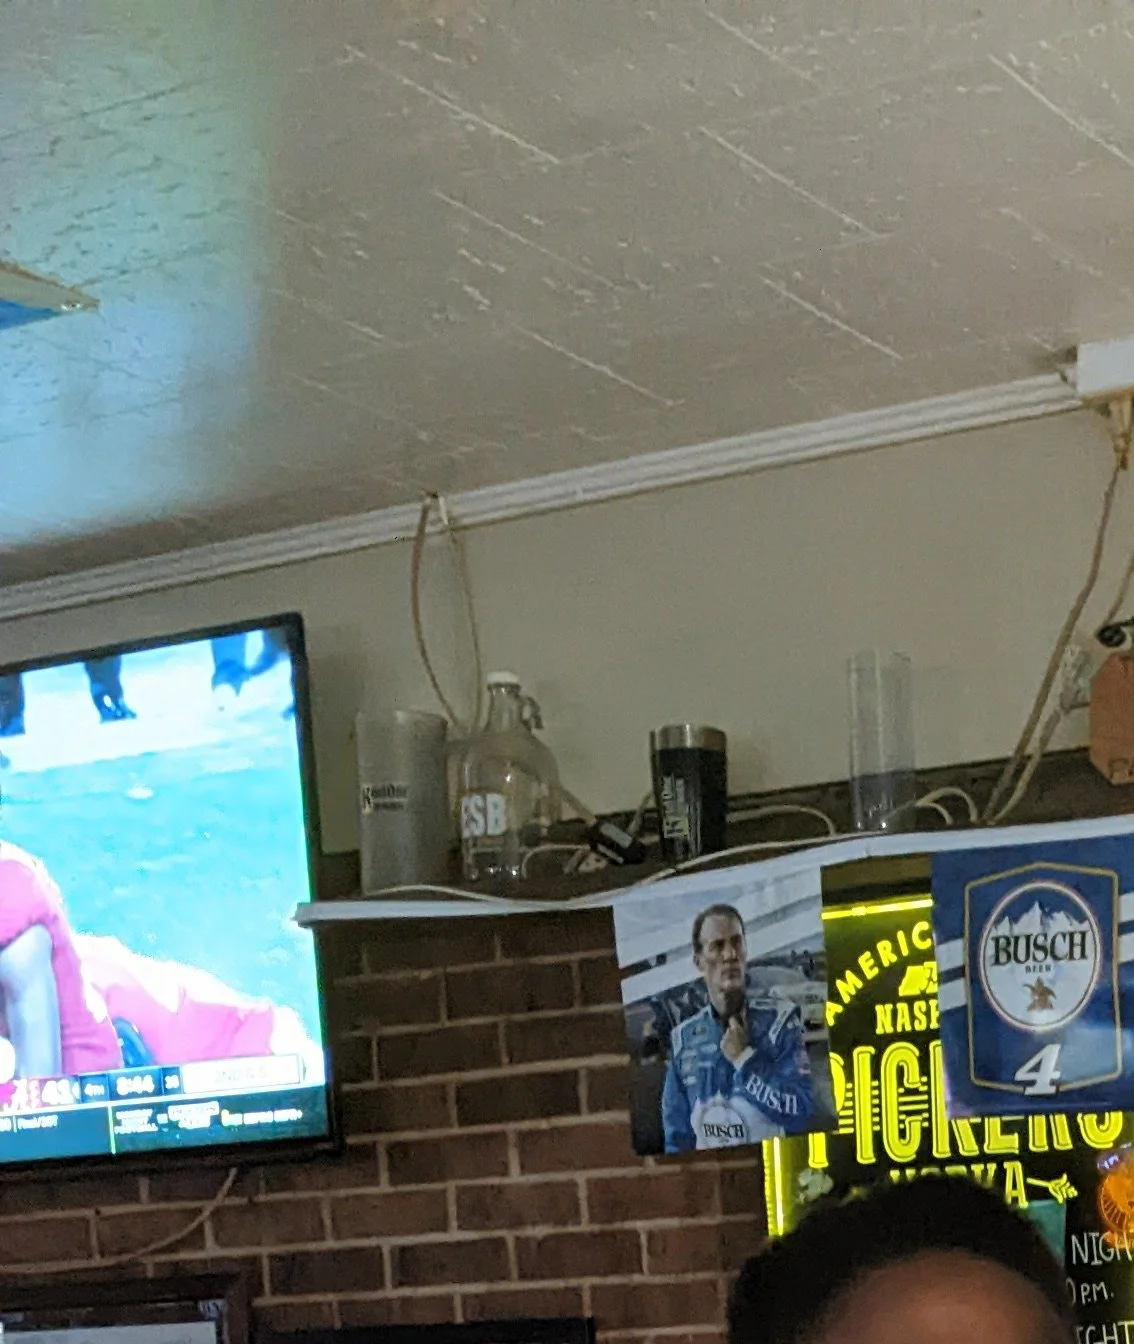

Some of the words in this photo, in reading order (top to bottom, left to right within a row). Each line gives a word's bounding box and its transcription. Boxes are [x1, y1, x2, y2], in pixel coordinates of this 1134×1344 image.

[990, 930, 1089, 966] BUSCH
[1025, 963, 1051, 974] BEER
[1014, 1043, 1063, 1096] 4
[745, 1073, 799, 1115] BUSCH
[703, 1123, 745, 1138] BUSCH
